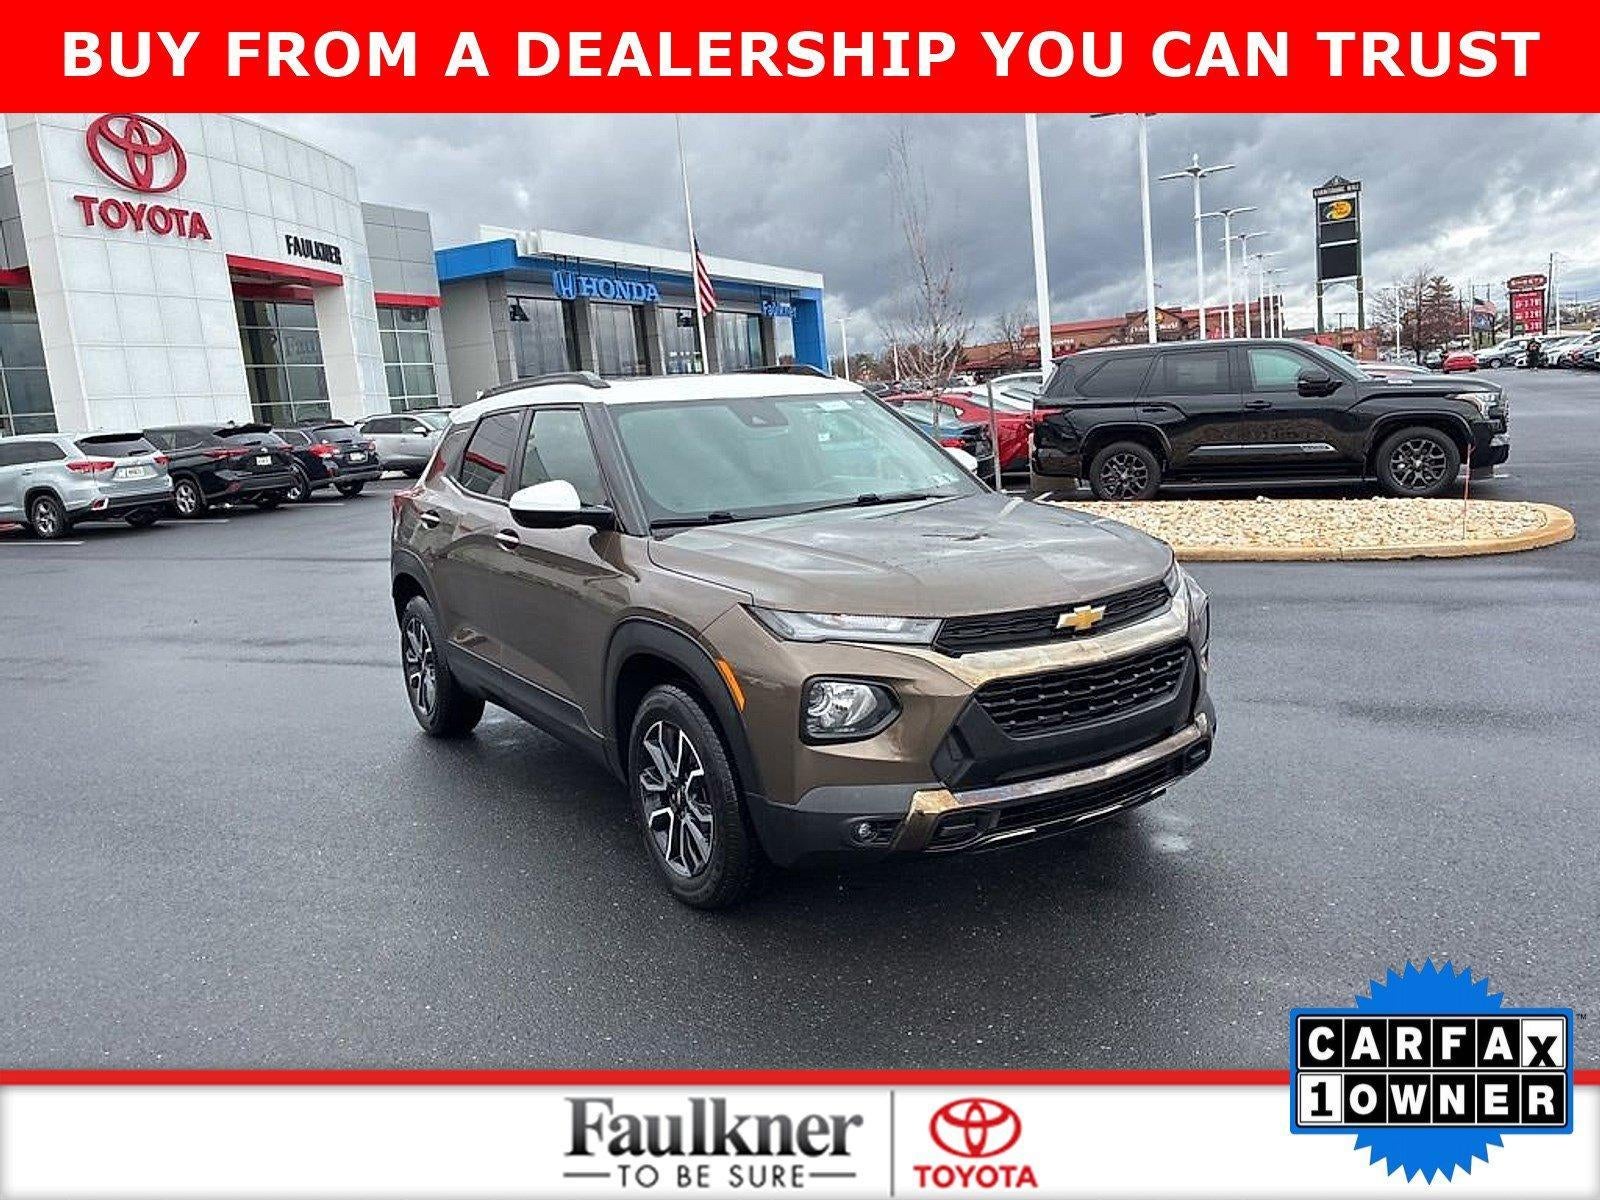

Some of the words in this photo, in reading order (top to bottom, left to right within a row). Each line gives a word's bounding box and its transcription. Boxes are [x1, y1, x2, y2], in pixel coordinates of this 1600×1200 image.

[74, 195, 212, 241] TOYOTA
[285, 234, 342, 265] FAULKNER
[577, 276, 660, 302] HONDA
